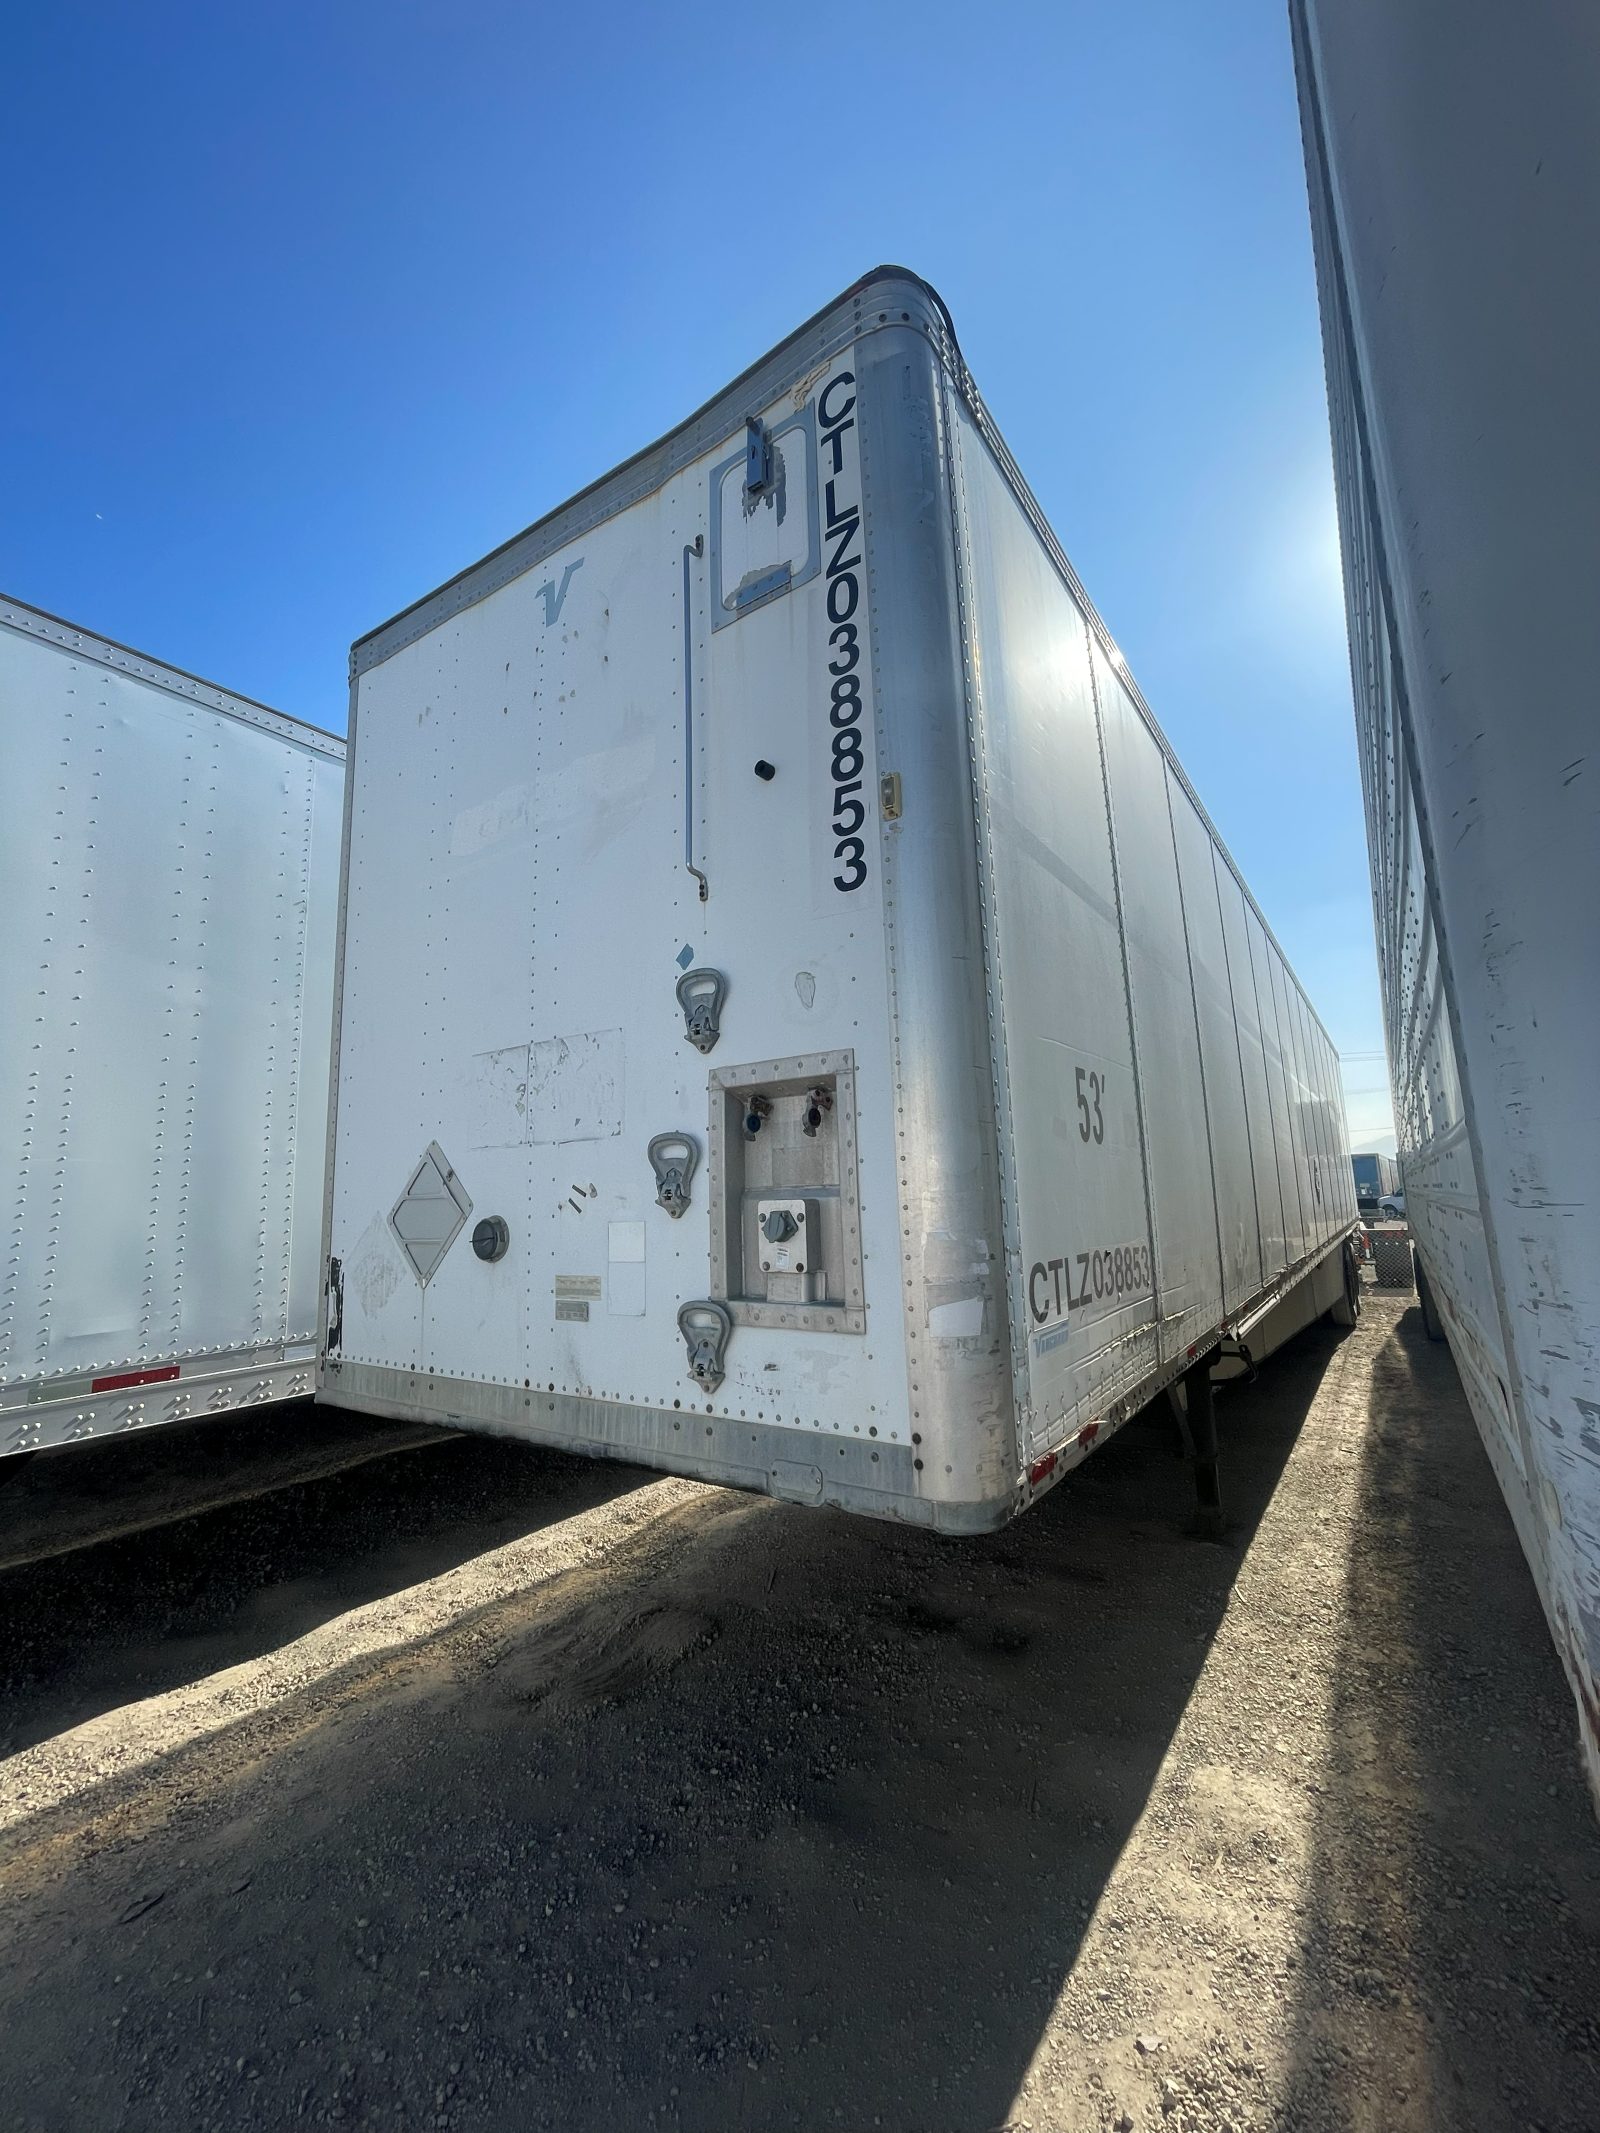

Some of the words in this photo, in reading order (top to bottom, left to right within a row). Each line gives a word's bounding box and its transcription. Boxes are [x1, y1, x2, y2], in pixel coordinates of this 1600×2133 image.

[817, 371, 868, 892] CTLZ038853
[1075, 1066, 1105, 1145] 53'
[1029, 1246, 1150, 1323] CTLZ038853
